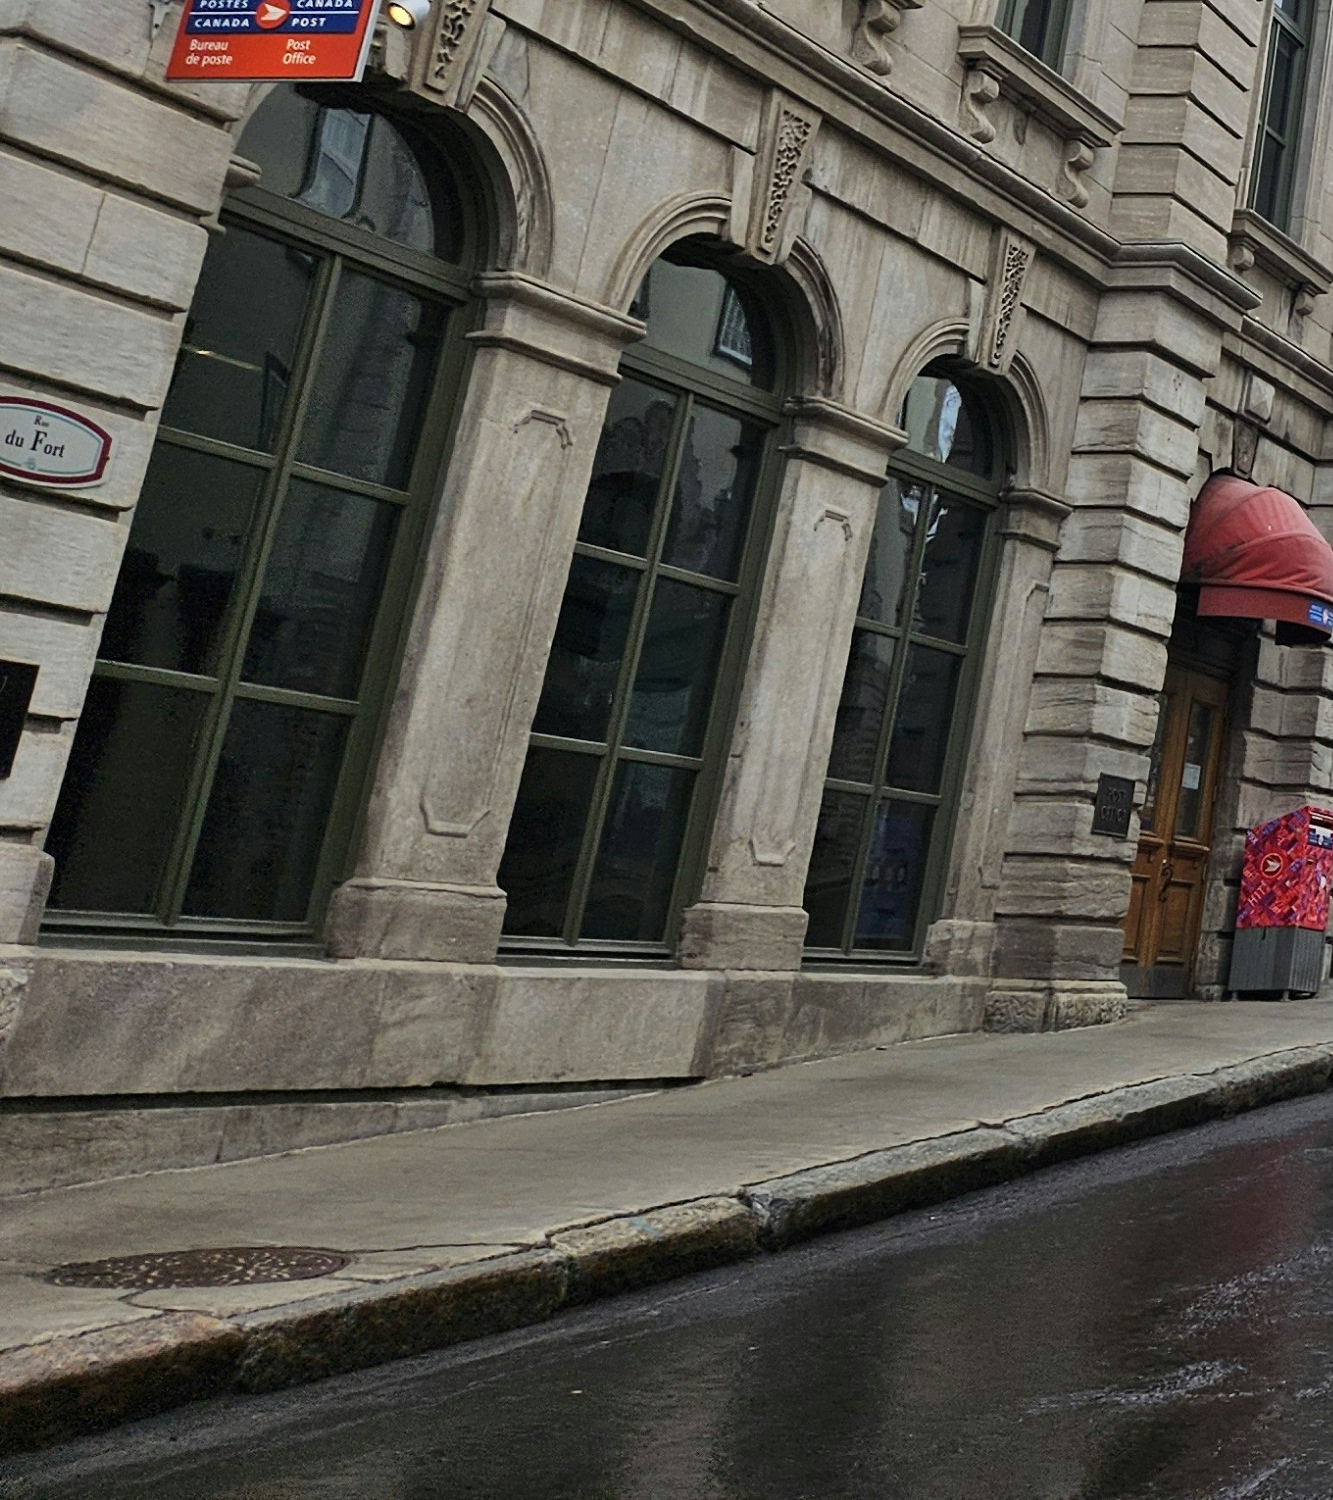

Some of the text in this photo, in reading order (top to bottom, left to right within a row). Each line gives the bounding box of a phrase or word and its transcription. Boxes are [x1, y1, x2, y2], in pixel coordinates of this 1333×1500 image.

[194, 18, 250, 28] CANADA
[291, 17, 326, 27] POST
[189, 38, 229, 51] Bureau
[286, 38, 310, 50] Post
[185, 54, 233, 67] de poste
[282, 52, 316, 65] Office
[5, 429, 65, 458] du Fort
